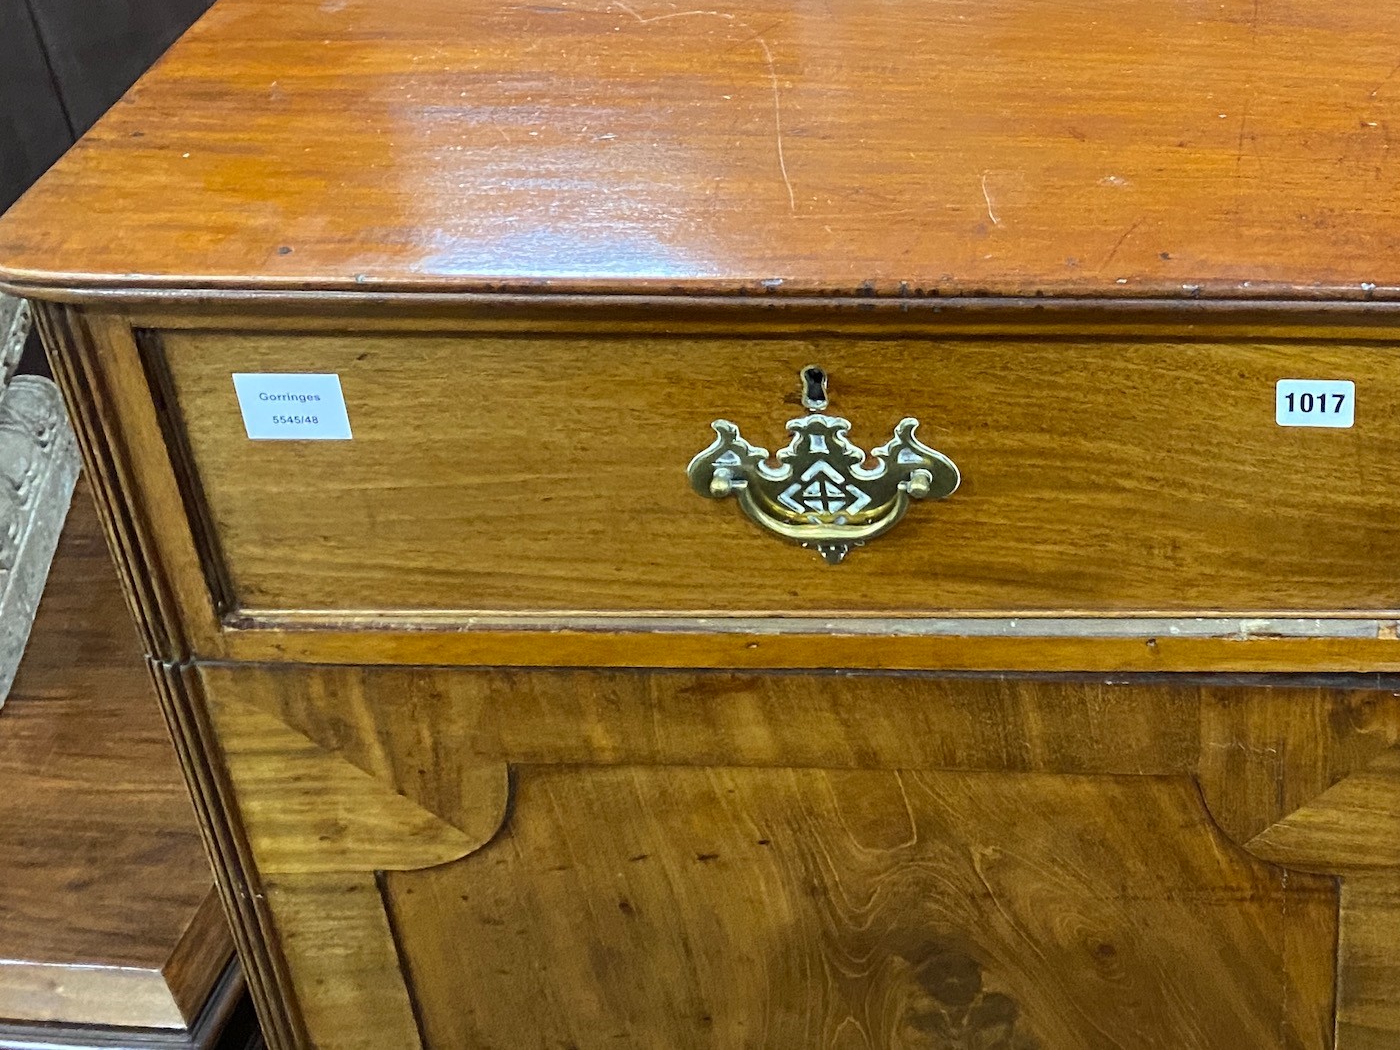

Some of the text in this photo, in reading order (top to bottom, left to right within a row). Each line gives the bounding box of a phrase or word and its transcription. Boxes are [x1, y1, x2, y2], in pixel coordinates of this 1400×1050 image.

[258, 392, 321, 403] Gorringes
[1285, 392, 1346, 413] 1017
[272, 415, 319, 425] 5545/48
